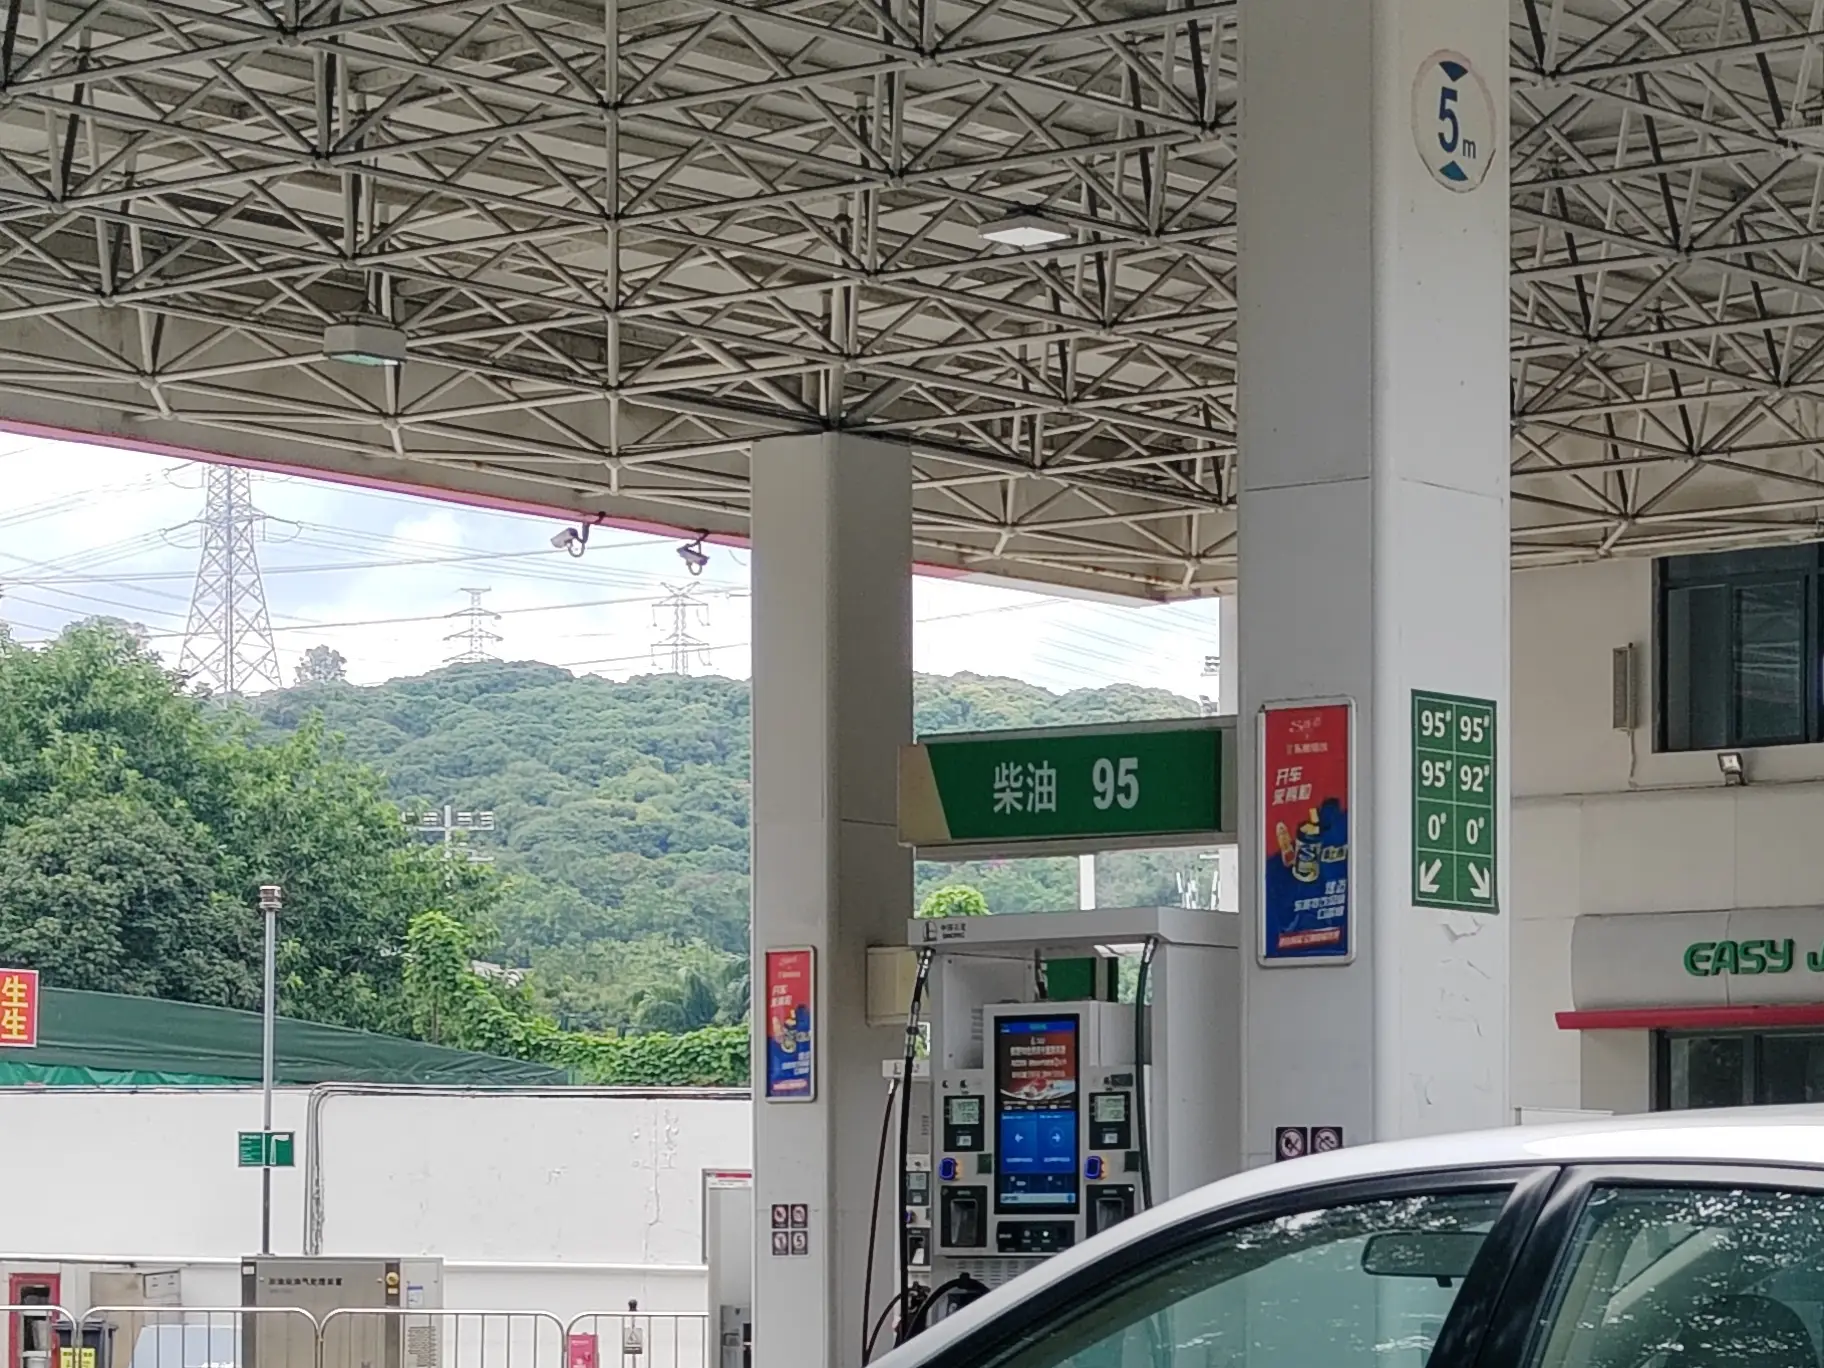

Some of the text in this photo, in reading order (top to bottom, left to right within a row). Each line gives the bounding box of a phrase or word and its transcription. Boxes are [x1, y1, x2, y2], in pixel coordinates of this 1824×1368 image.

[992, 756, 1139, 815] 柴油 95
[1684, 938, 1794, 977] EASY
